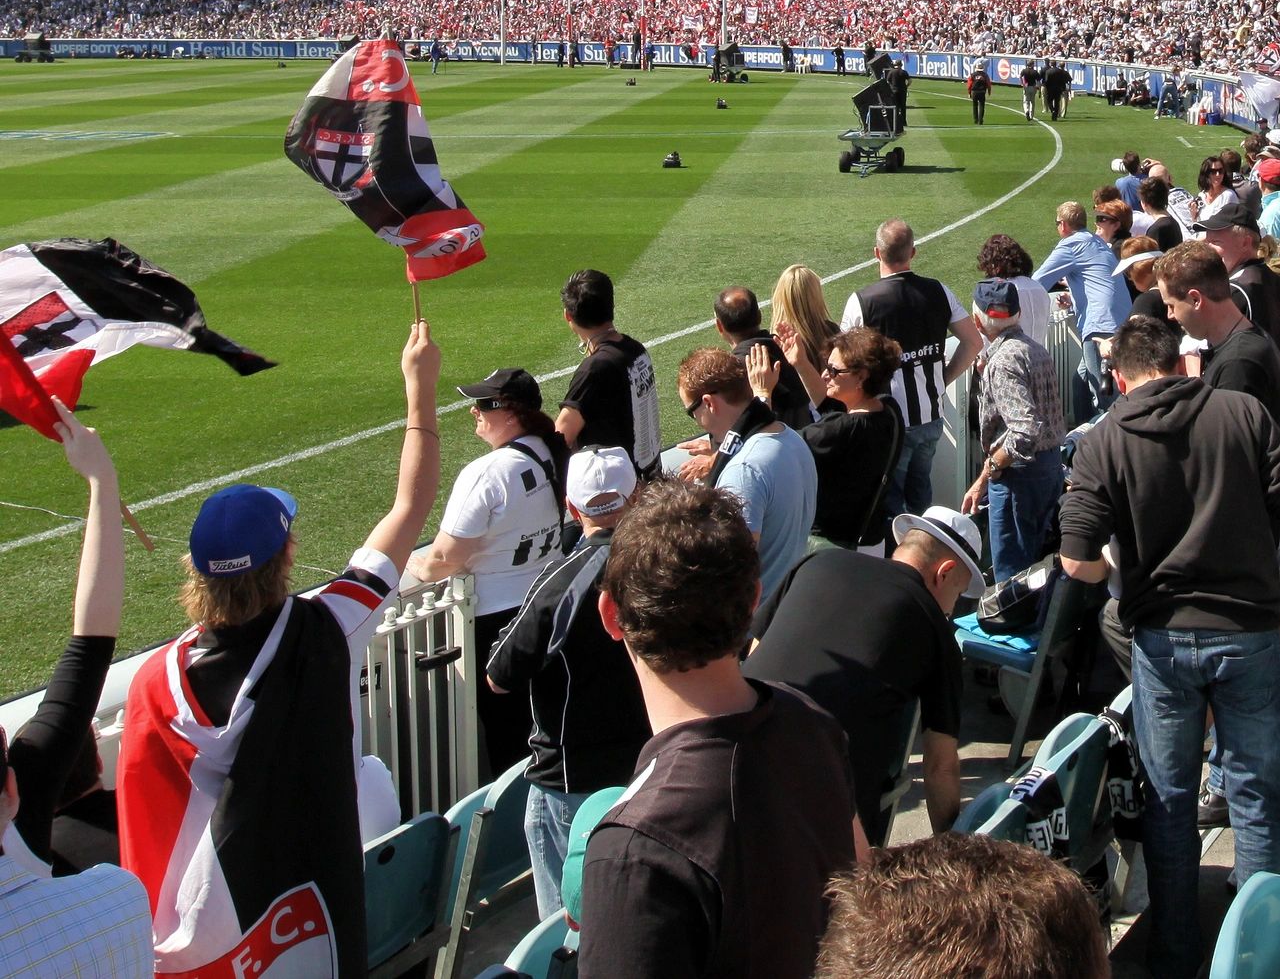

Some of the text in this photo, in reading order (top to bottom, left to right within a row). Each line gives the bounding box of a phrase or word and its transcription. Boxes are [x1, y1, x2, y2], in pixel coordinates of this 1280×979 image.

[189, 41, 287, 56] Herald Sun
[295, 42, 341, 57] Heral
[916, 54, 958, 77] Herald
